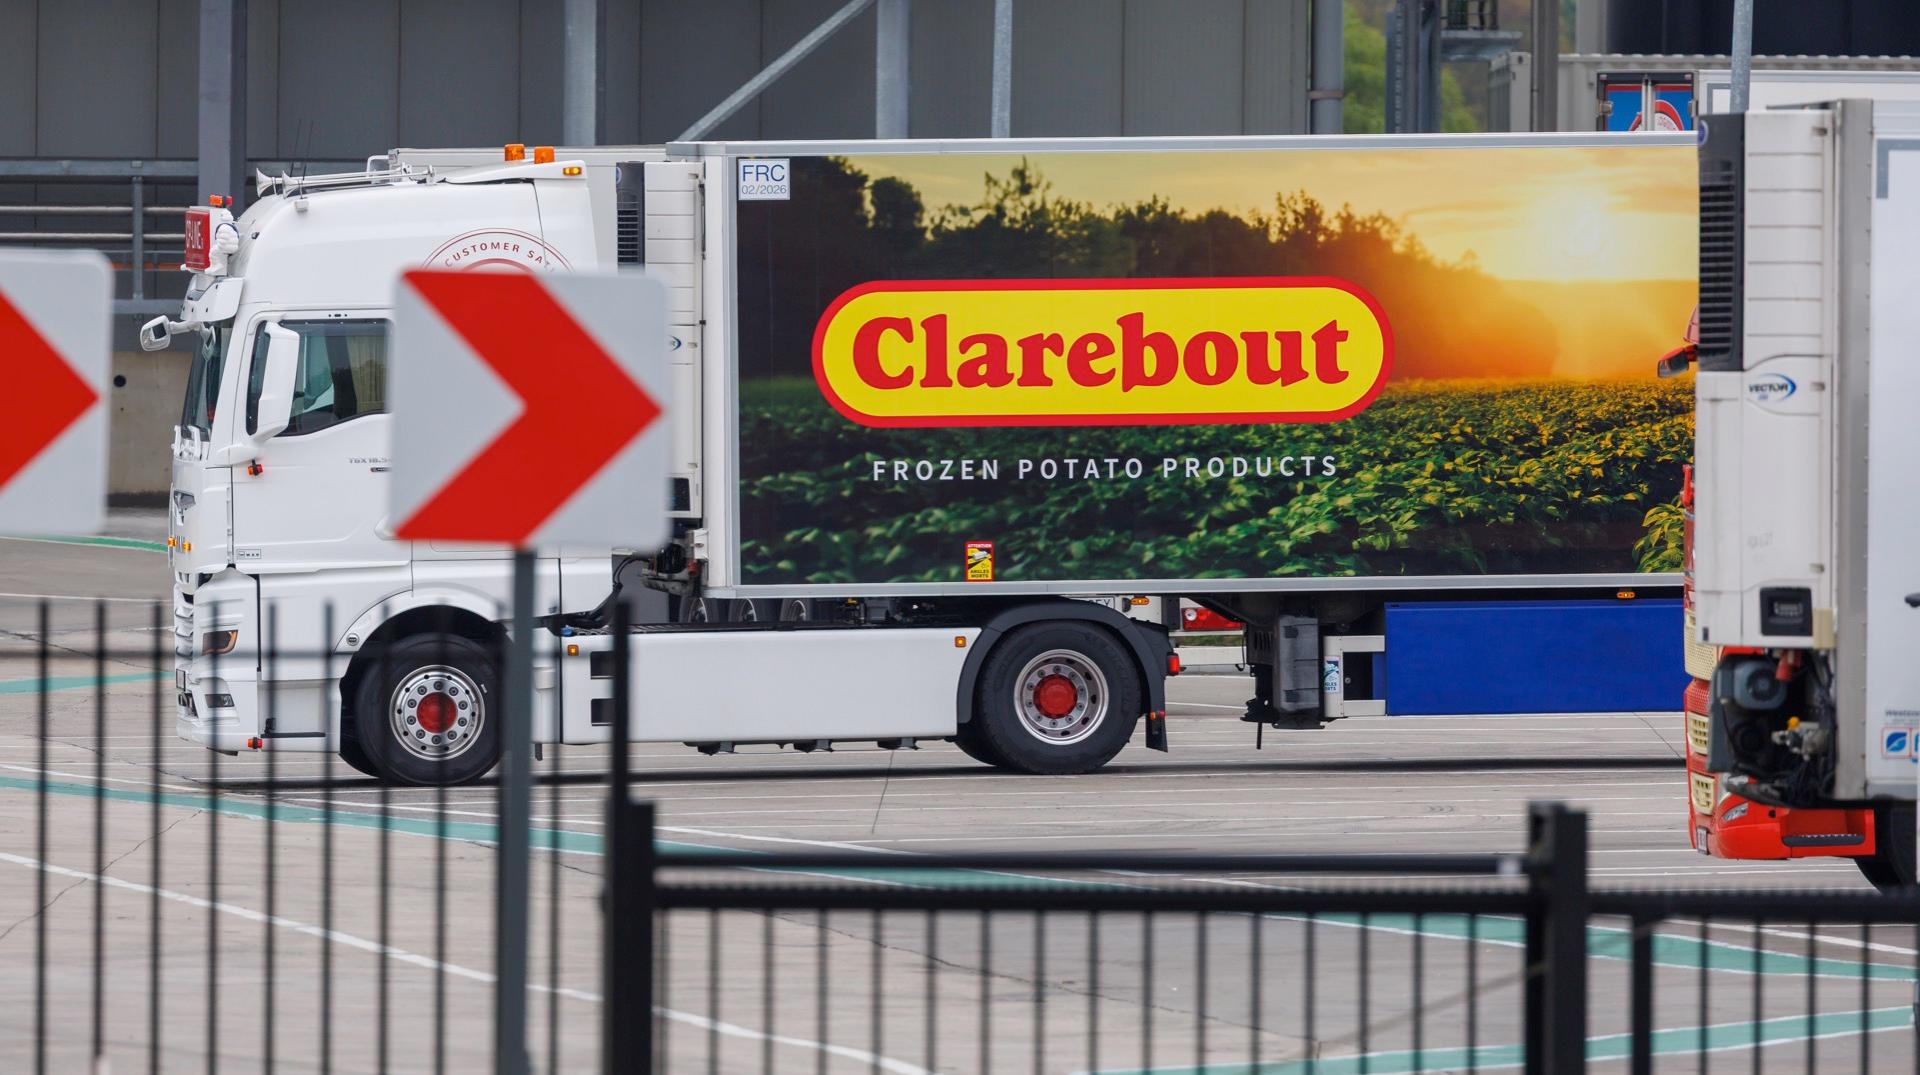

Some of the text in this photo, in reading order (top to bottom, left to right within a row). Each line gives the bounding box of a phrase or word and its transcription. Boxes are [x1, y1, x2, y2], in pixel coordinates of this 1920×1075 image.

[742, 164, 785, 182] FRC
[741, 184, 787, 195] 02/2026
[444, 242, 520, 268] CUSTOMER
[852, 312, 1350, 393] Clarebout
[1748, 383, 1789, 393] VECTOR
[872, 455, 1338, 481] FROZEN POTATO PRODUCTS
